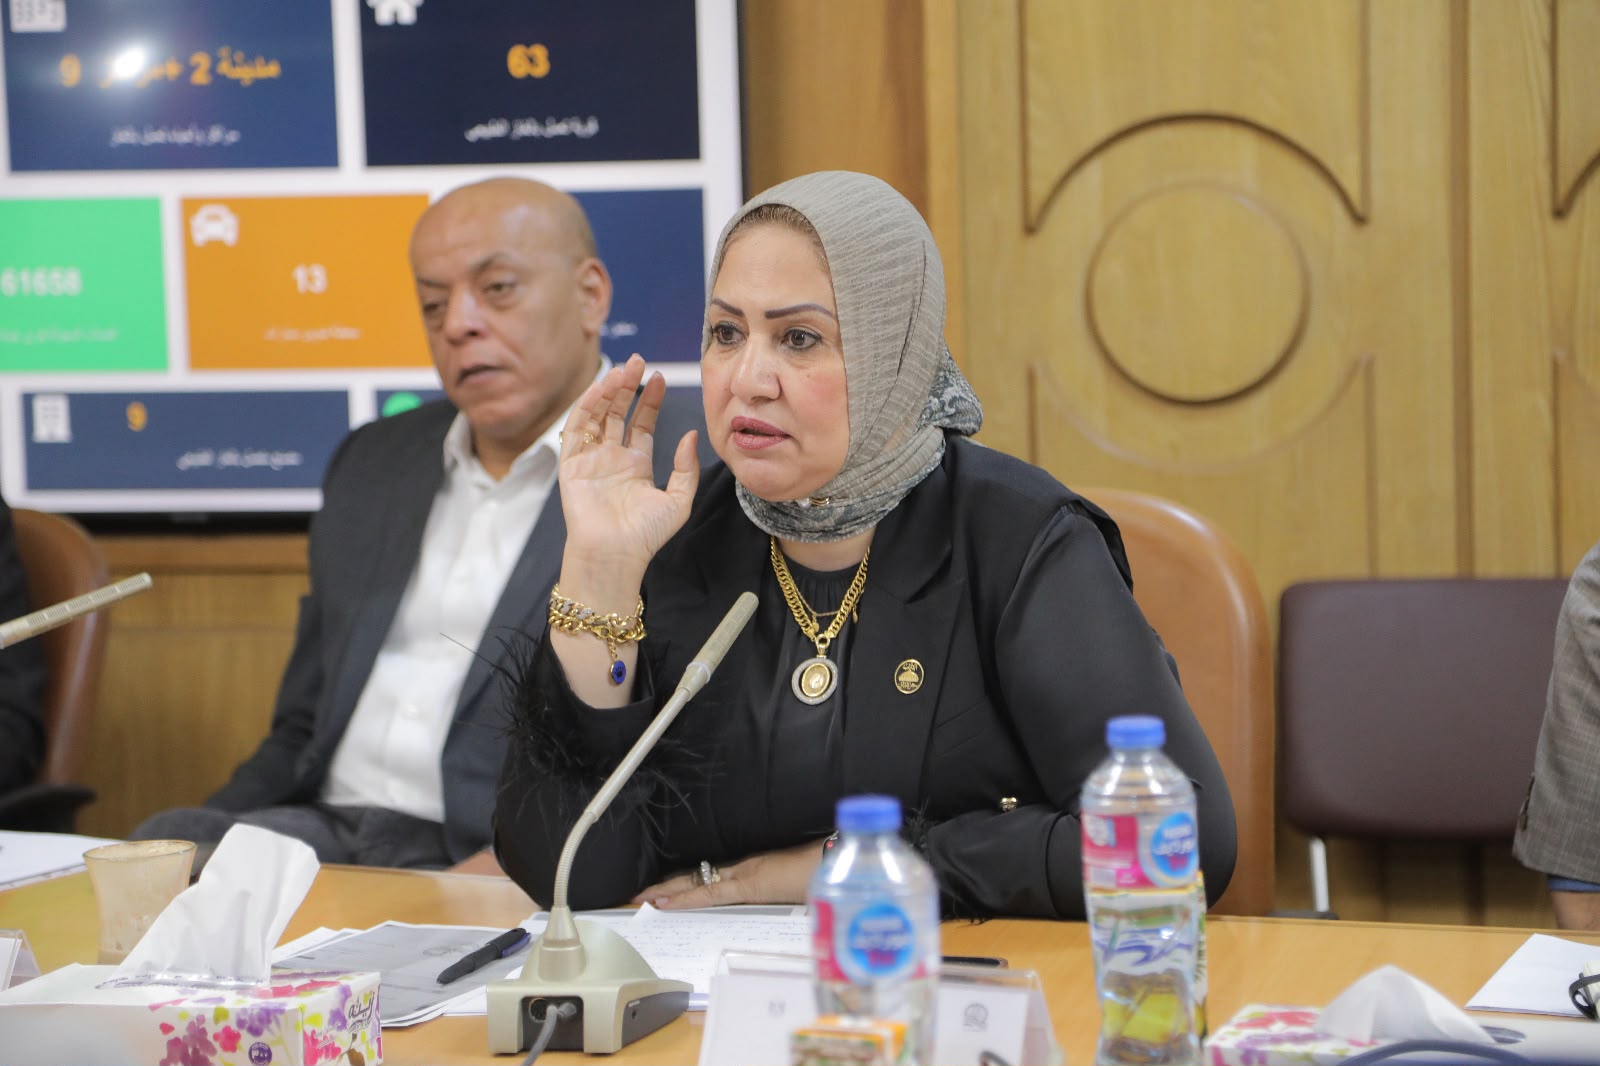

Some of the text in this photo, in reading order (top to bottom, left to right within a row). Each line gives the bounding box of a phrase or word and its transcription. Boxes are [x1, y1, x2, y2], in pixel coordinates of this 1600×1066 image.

[59, 53, 82, 88] 9
[189, 51, 213, 86] 2
[506, 43, 550, 79] 63
[292, 263, 328, 294] 13
[125, 400, 148, 432] 9
